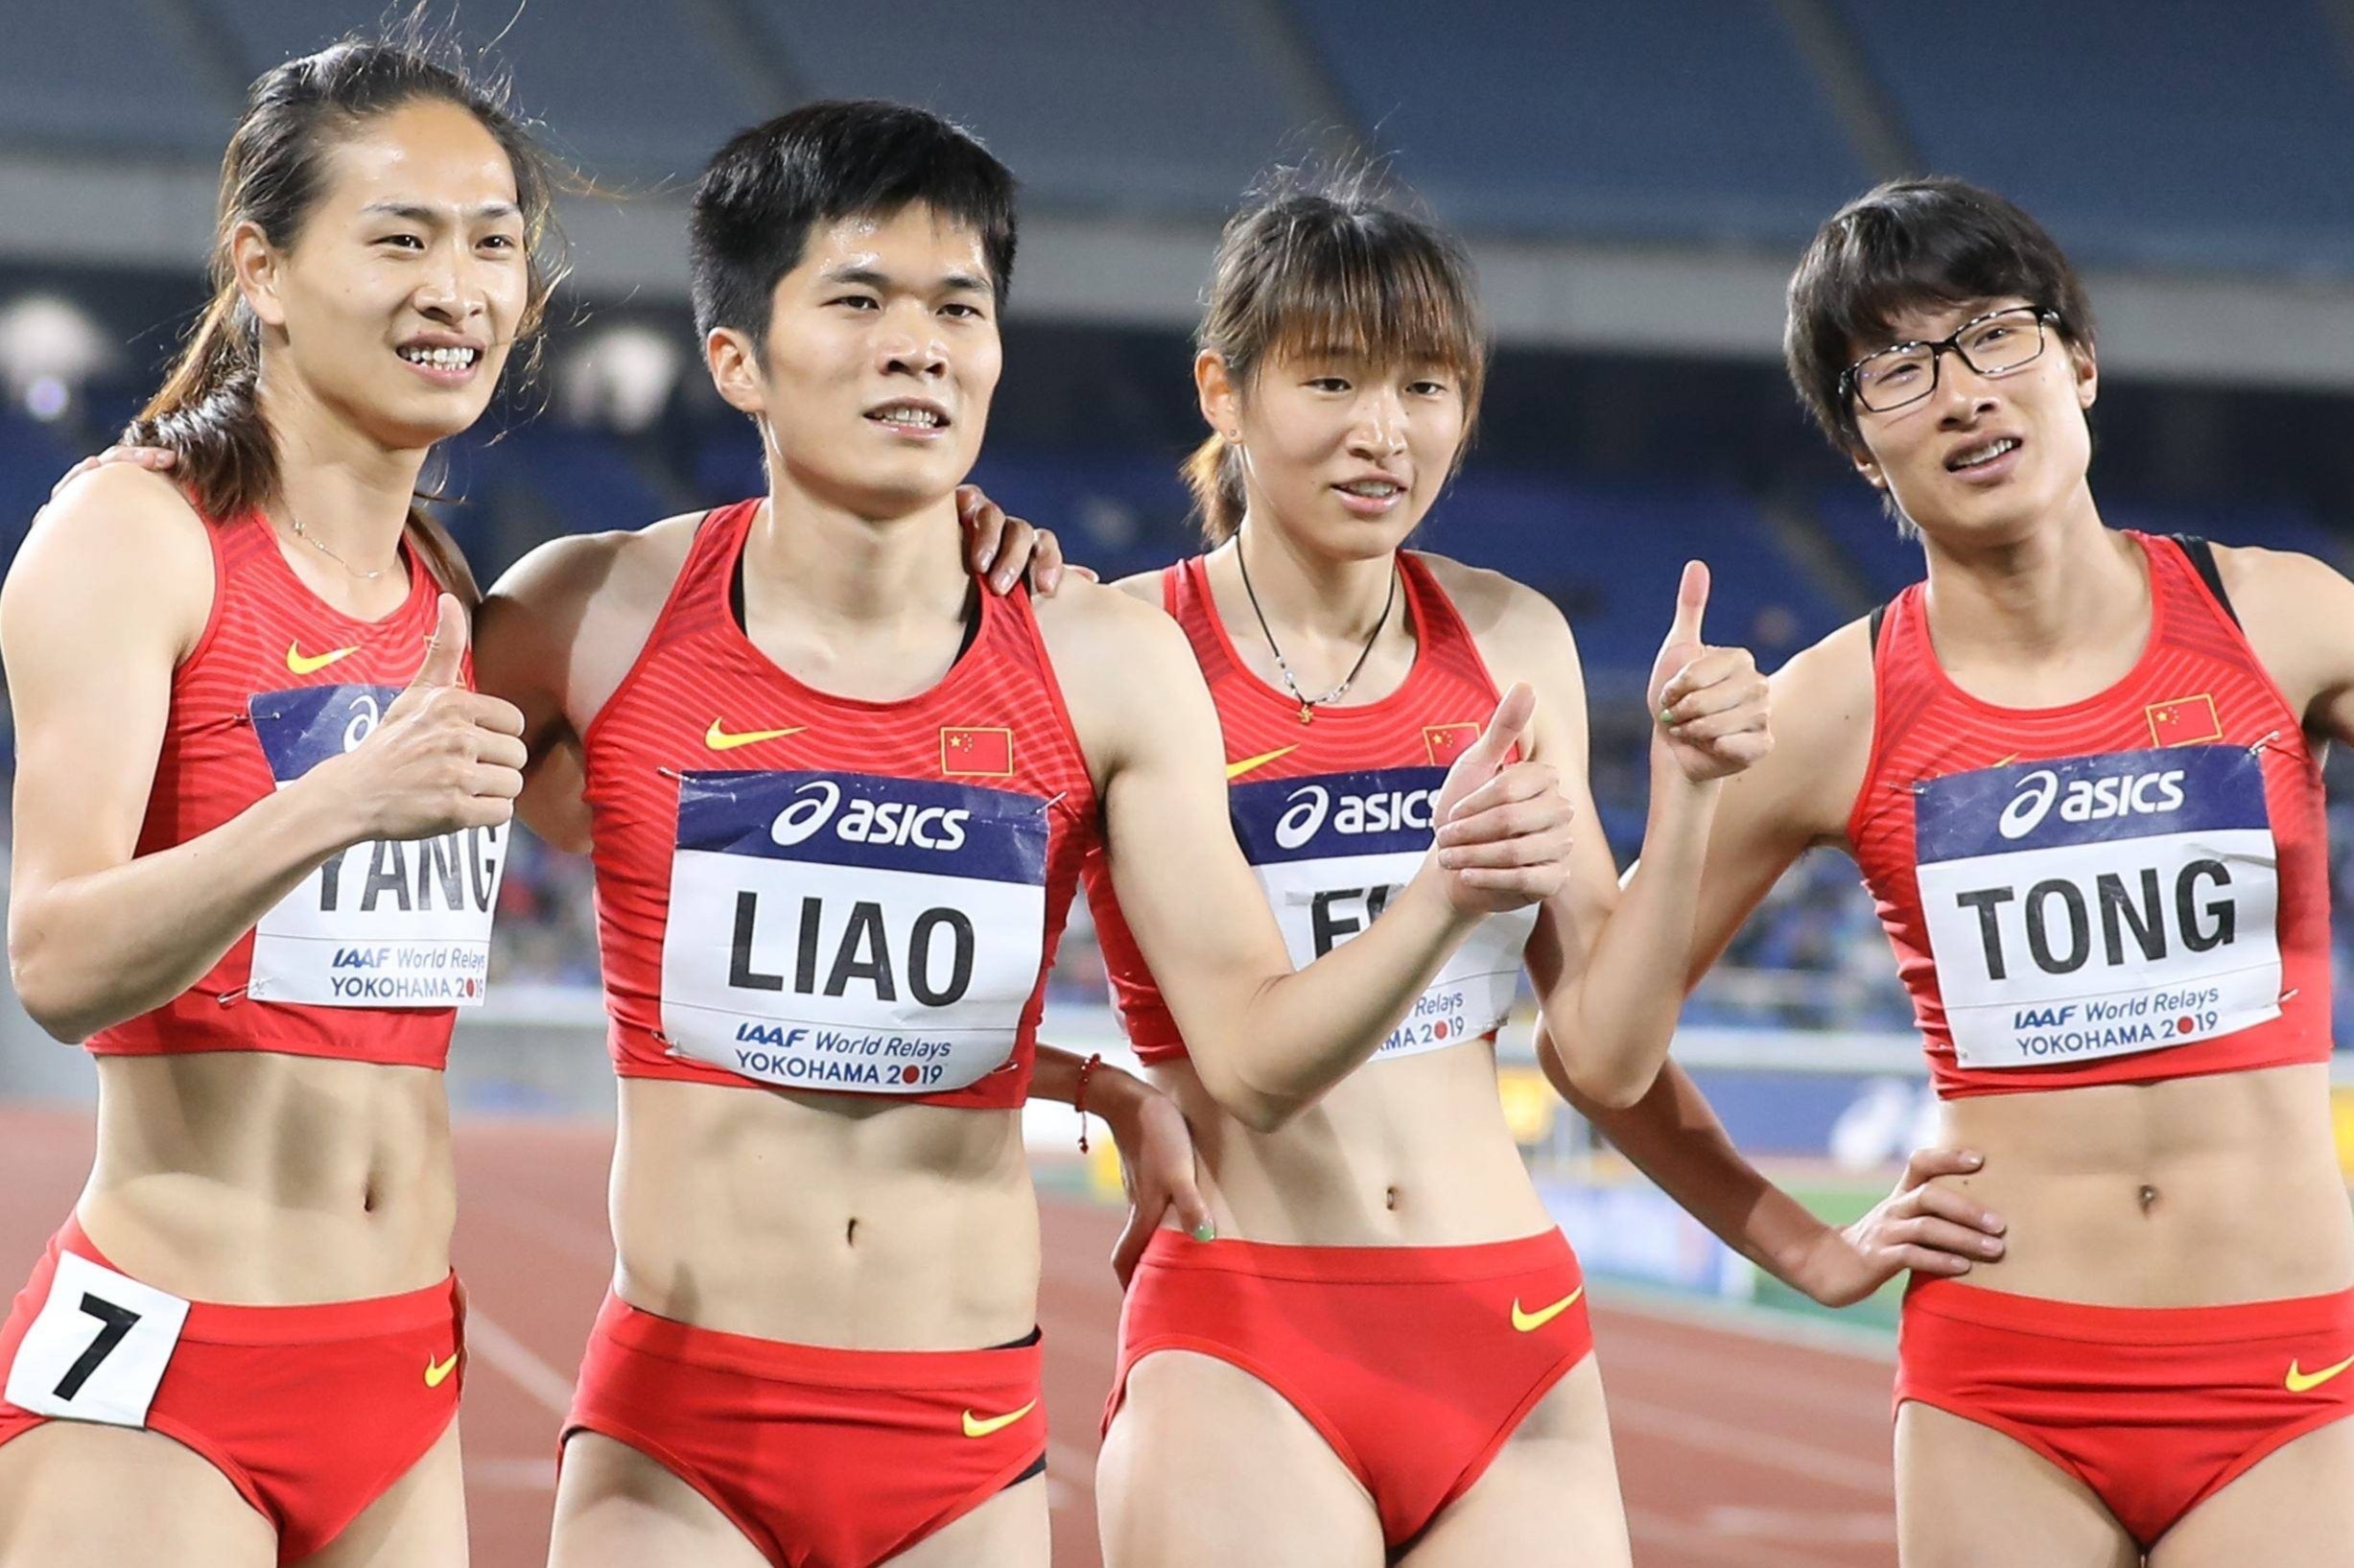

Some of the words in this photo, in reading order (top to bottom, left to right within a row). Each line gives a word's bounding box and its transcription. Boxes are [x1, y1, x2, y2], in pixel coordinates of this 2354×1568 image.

[2060, 769, 2185, 822] asics
[836, 798, 971, 851] asics
[1956, 859, 2236, 981] TONG
[332, 948, 391, 969] IAAF
[397, 948, 447, 969] World
[451, 948, 485, 974] Relays
[728, 890, 976, 1008] LIAO
[330, 976, 452, 998] YOKOHAMA
[1414, 992, 1464, 1018] Relays
[2013, 1004, 2078, 1030] IAAF
[2085, 995, 2147, 1022] World
[2154, 986, 2220, 1014] Relays
[735, 1021, 810, 1048] IAAF
[815, 1030, 881, 1056] World
[886, 1037, 953, 1059] Relays
[2016, 1026, 2155, 1057] YOKOHAMA
[735, 1049, 880, 1085] YOKOHAMA
[52, 1291, 142, 1401] 7
